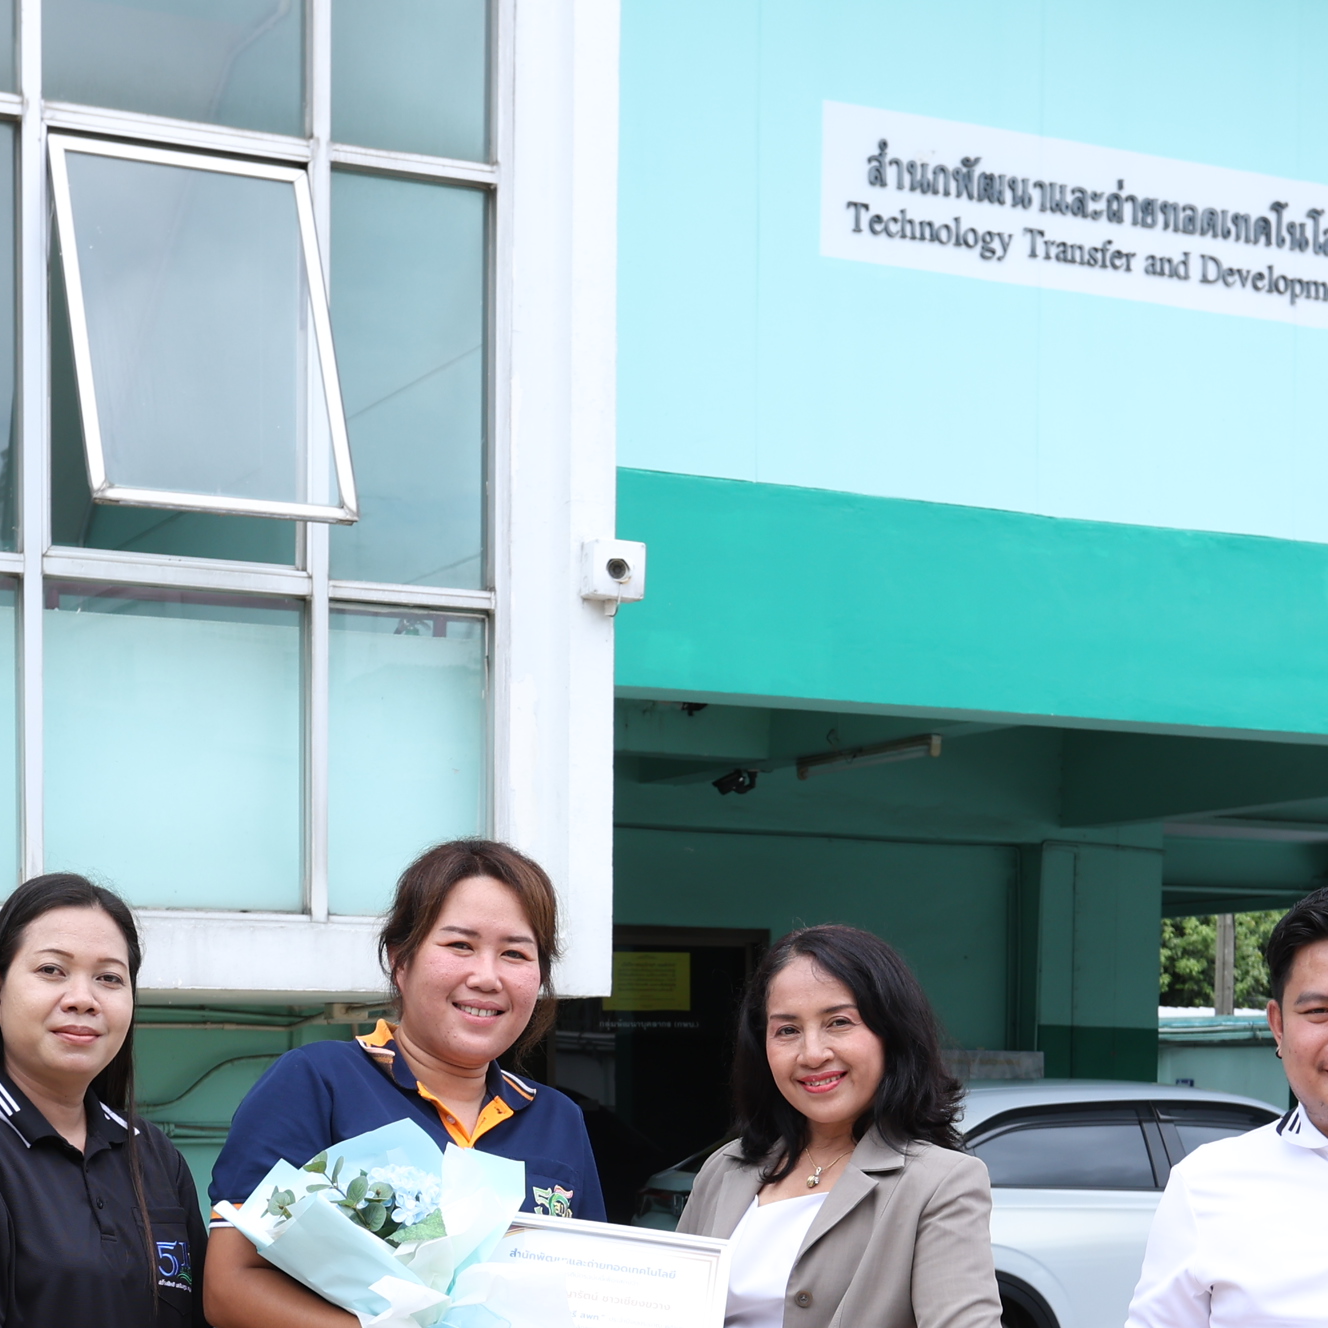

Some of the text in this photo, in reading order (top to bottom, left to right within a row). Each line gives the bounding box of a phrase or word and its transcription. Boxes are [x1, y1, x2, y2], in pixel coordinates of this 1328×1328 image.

[847, 201, 1014, 261] Technology
[1023, 227, 1136, 273] Transfer
[1144, 252, 1191, 281] and
